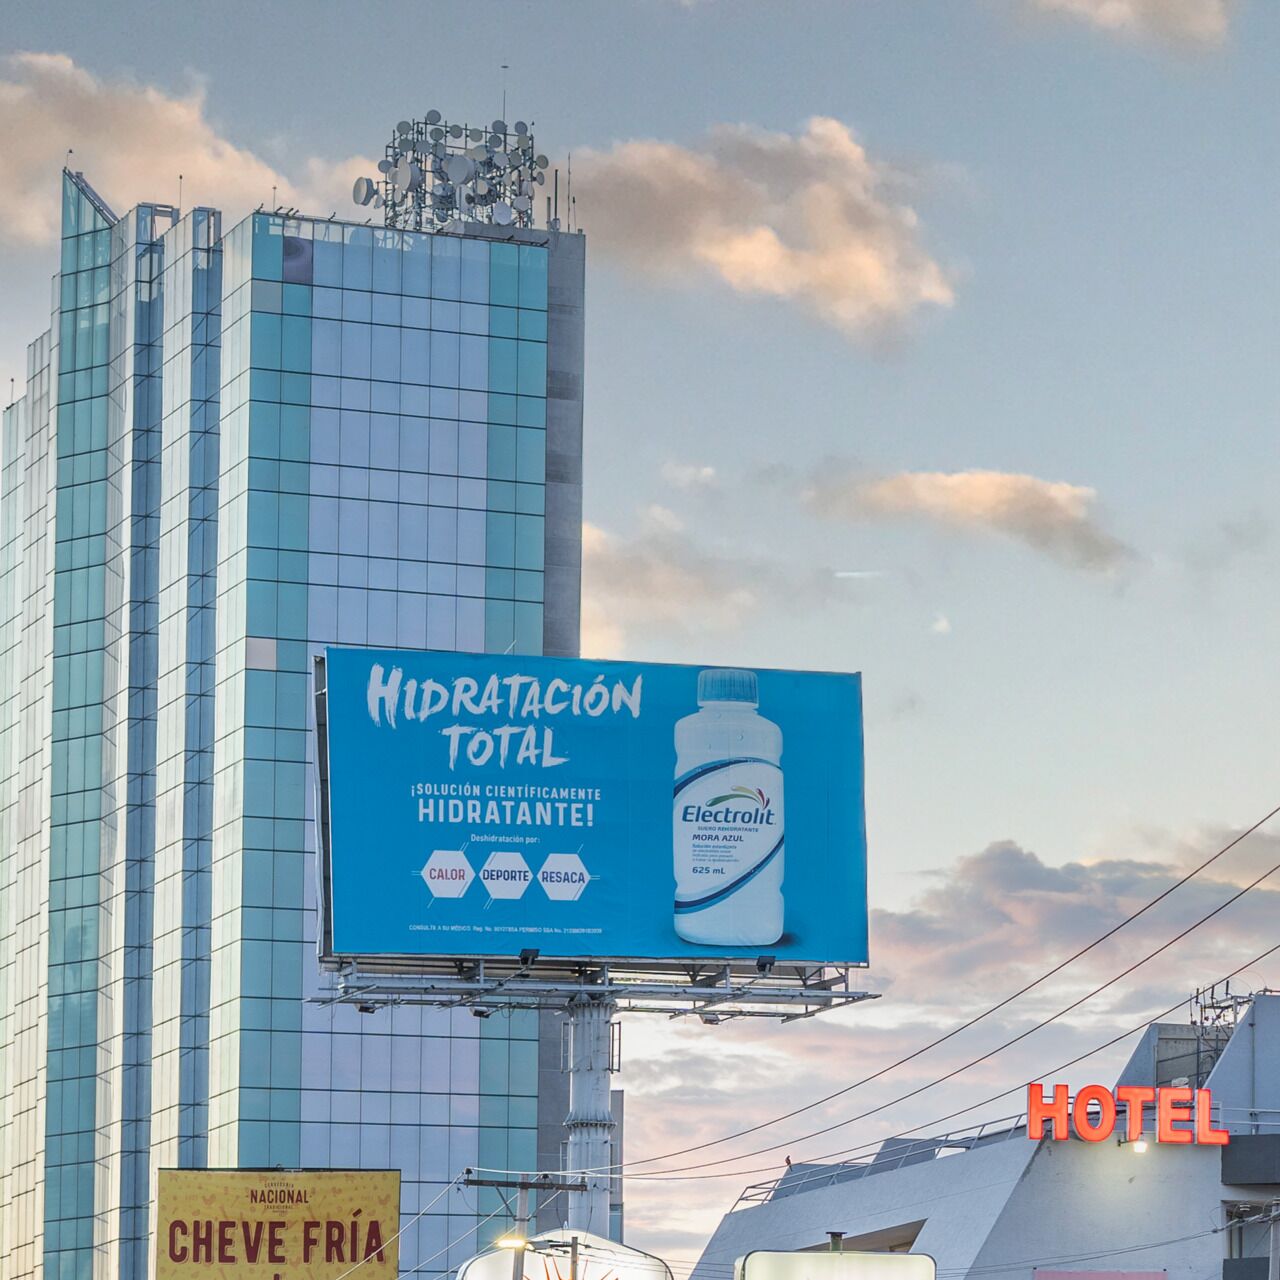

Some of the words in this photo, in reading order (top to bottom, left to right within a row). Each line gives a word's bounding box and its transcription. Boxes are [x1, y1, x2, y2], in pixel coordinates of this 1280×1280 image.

[366, 662, 643, 729] HIDRATACIÓN
[441, 723, 571, 771] TOTAL
[411, 781, 481, 797] ¡SOLUCIÓN
[485, 784, 601, 801] CIENTÍFICAMENTE
[418, 798, 594, 828] HIDRATANTE!
[682, 805, 775, 826] Electrolit
[692, 834, 720, 842] MORA
[722, 834, 744, 842] AZUL
[429, 867, 466, 881] CALOR
[482, 869, 530, 882] DEPORTE
[541, 870, 586, 884] RESACA
[692, 866, 711, 874] 625
[1026, 1082, 1230, 1147] HOTEL
[250, 1189, 309, 1204] NACIONAL
[169, 1219, 288, 1264] CHEVE
[303, 1208, 386, 1264] FRÍA
